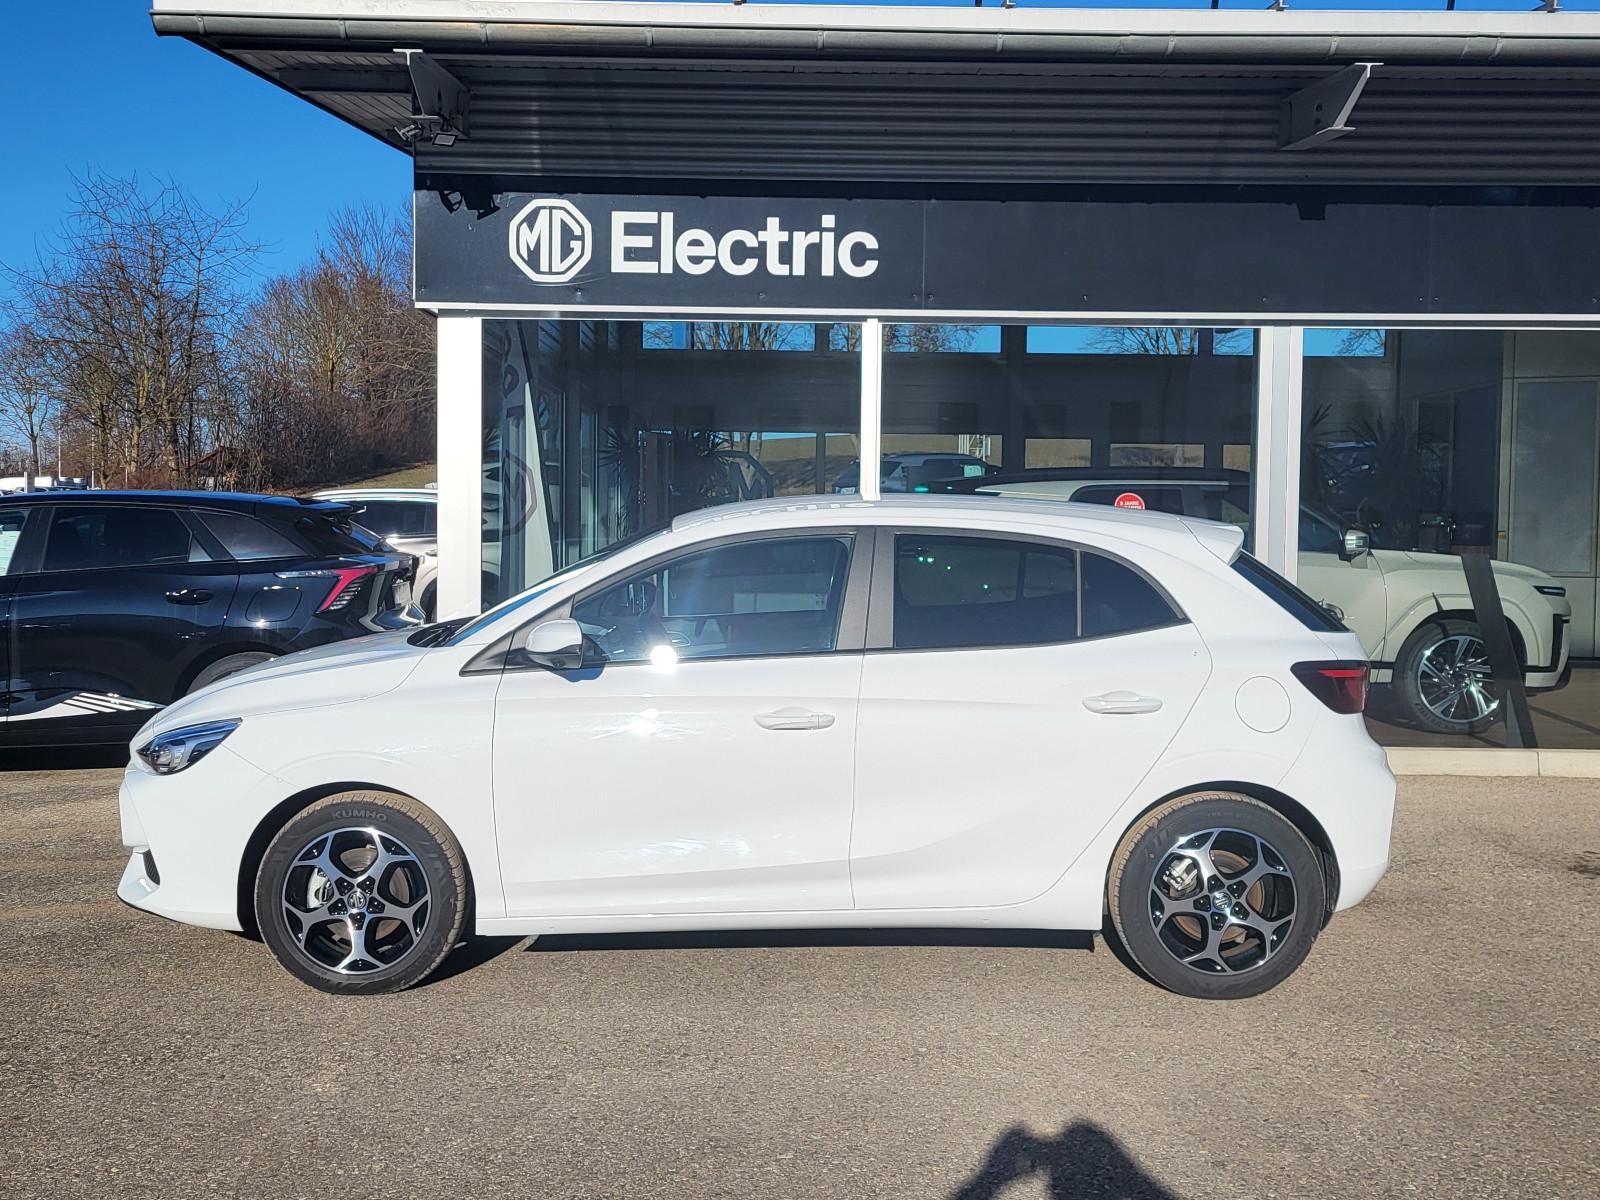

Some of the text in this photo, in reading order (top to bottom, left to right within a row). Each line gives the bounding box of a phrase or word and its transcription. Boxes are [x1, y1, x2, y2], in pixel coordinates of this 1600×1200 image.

[516, 206, 880, 279] MG Electric
[331, 808, 388, 822] KUMHO
